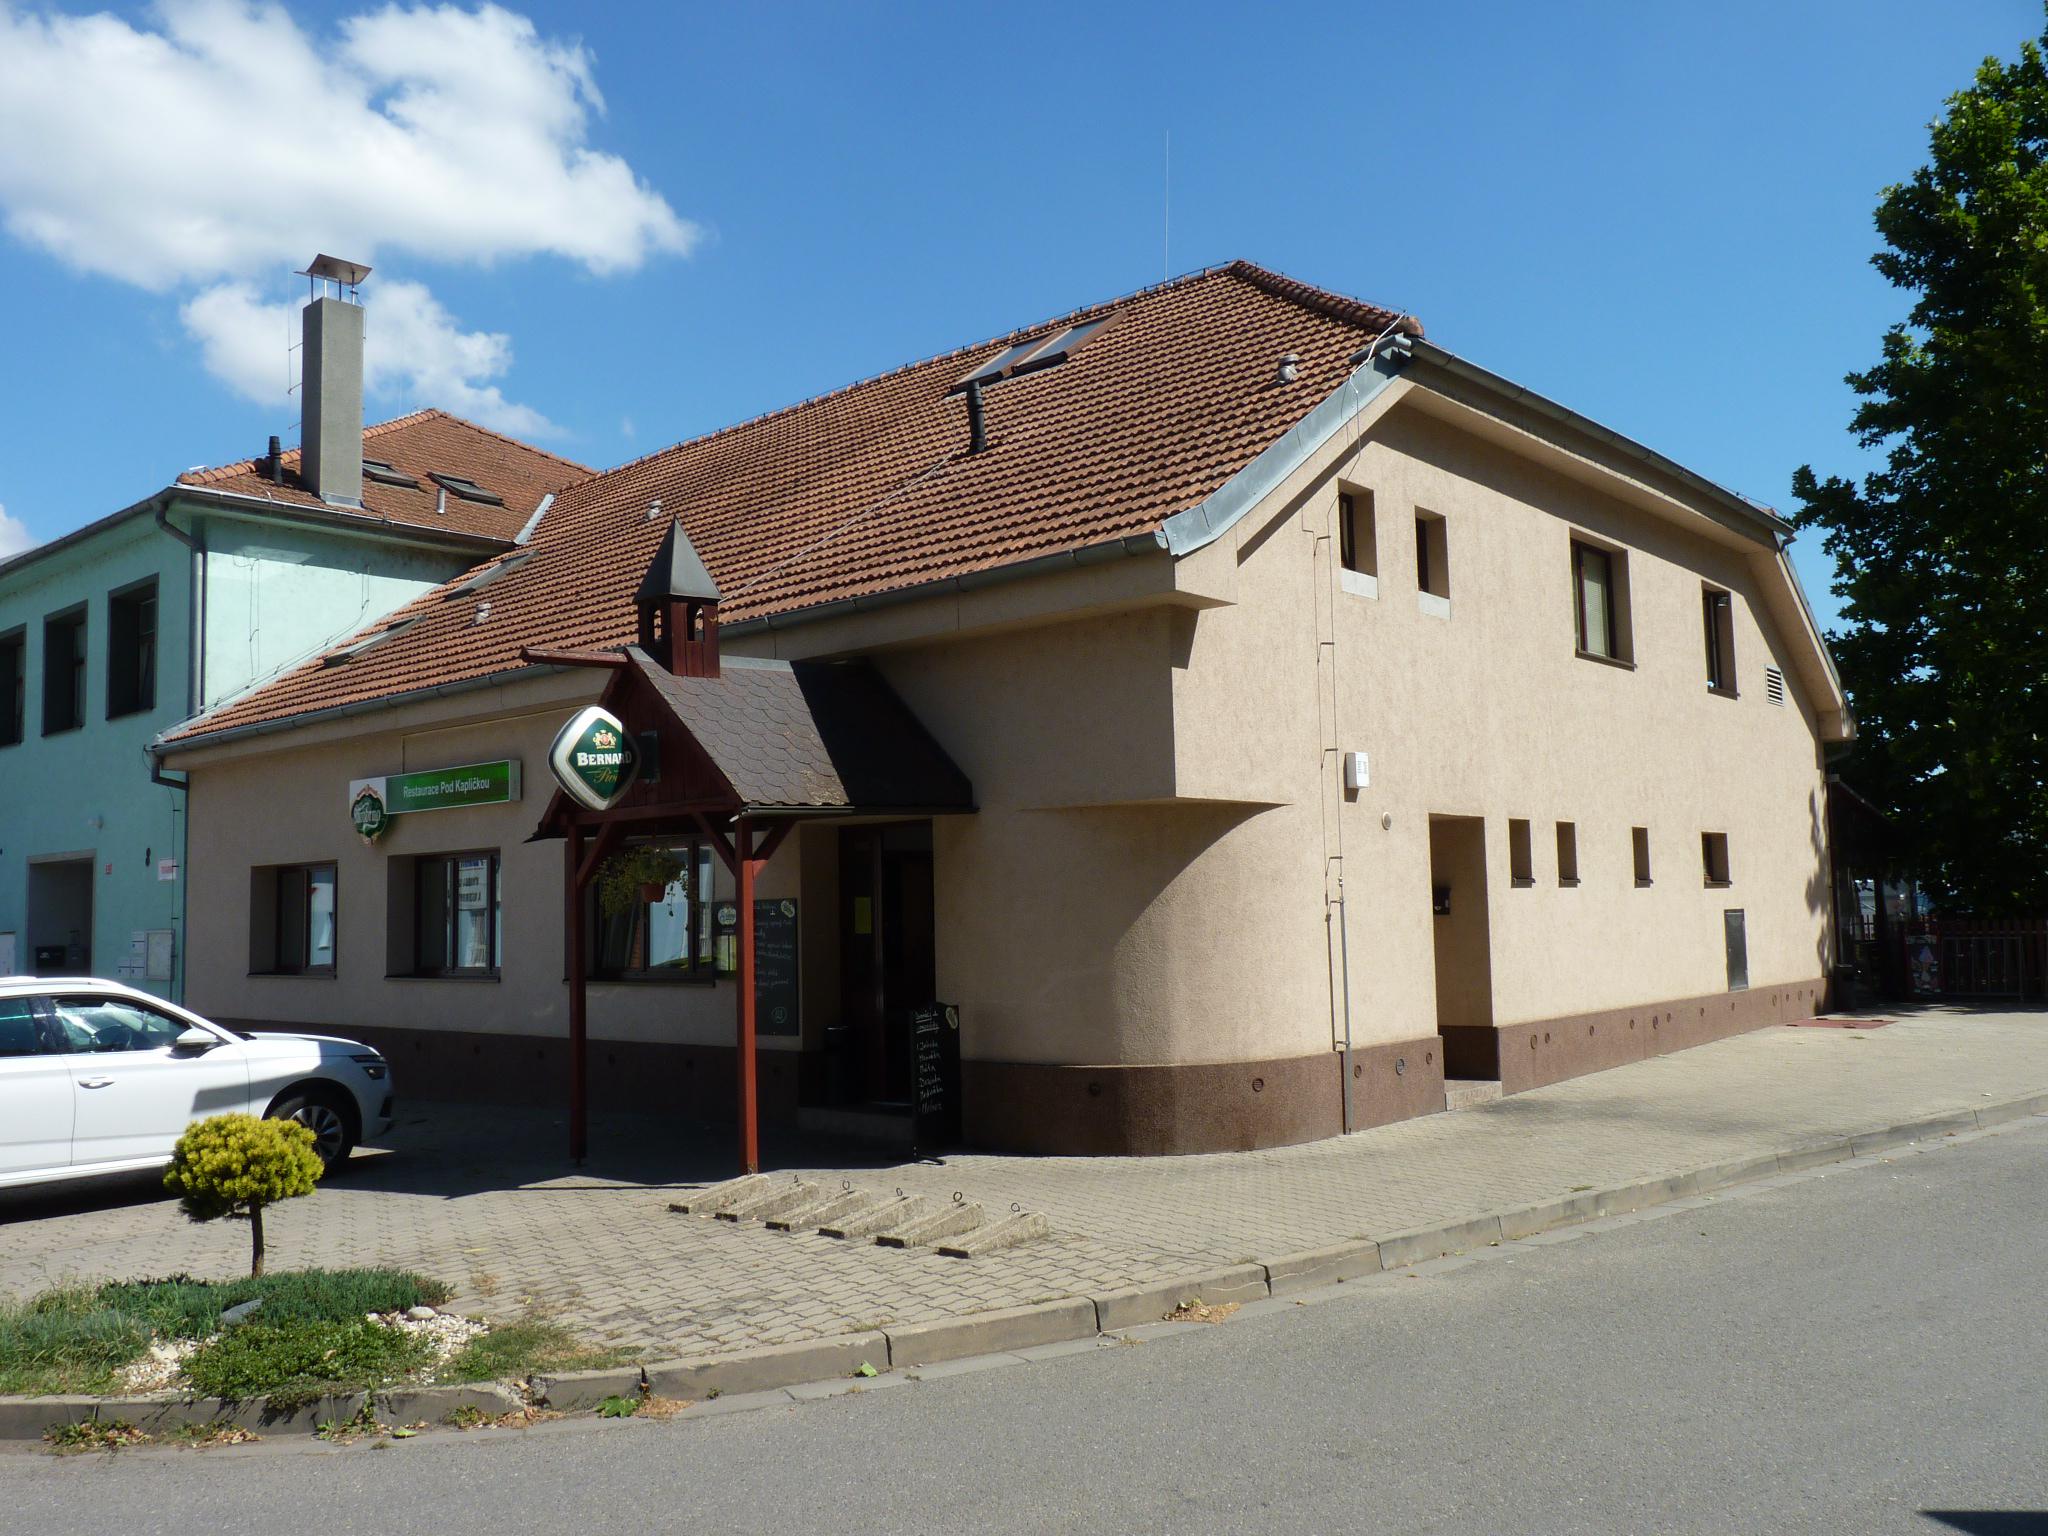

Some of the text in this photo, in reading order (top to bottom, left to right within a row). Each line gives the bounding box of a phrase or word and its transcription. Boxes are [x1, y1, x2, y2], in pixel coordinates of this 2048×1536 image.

[577, 750, 632, 766] BERNARD
[403, 777, 490, 798] Restaurace Pod Kapličkou
